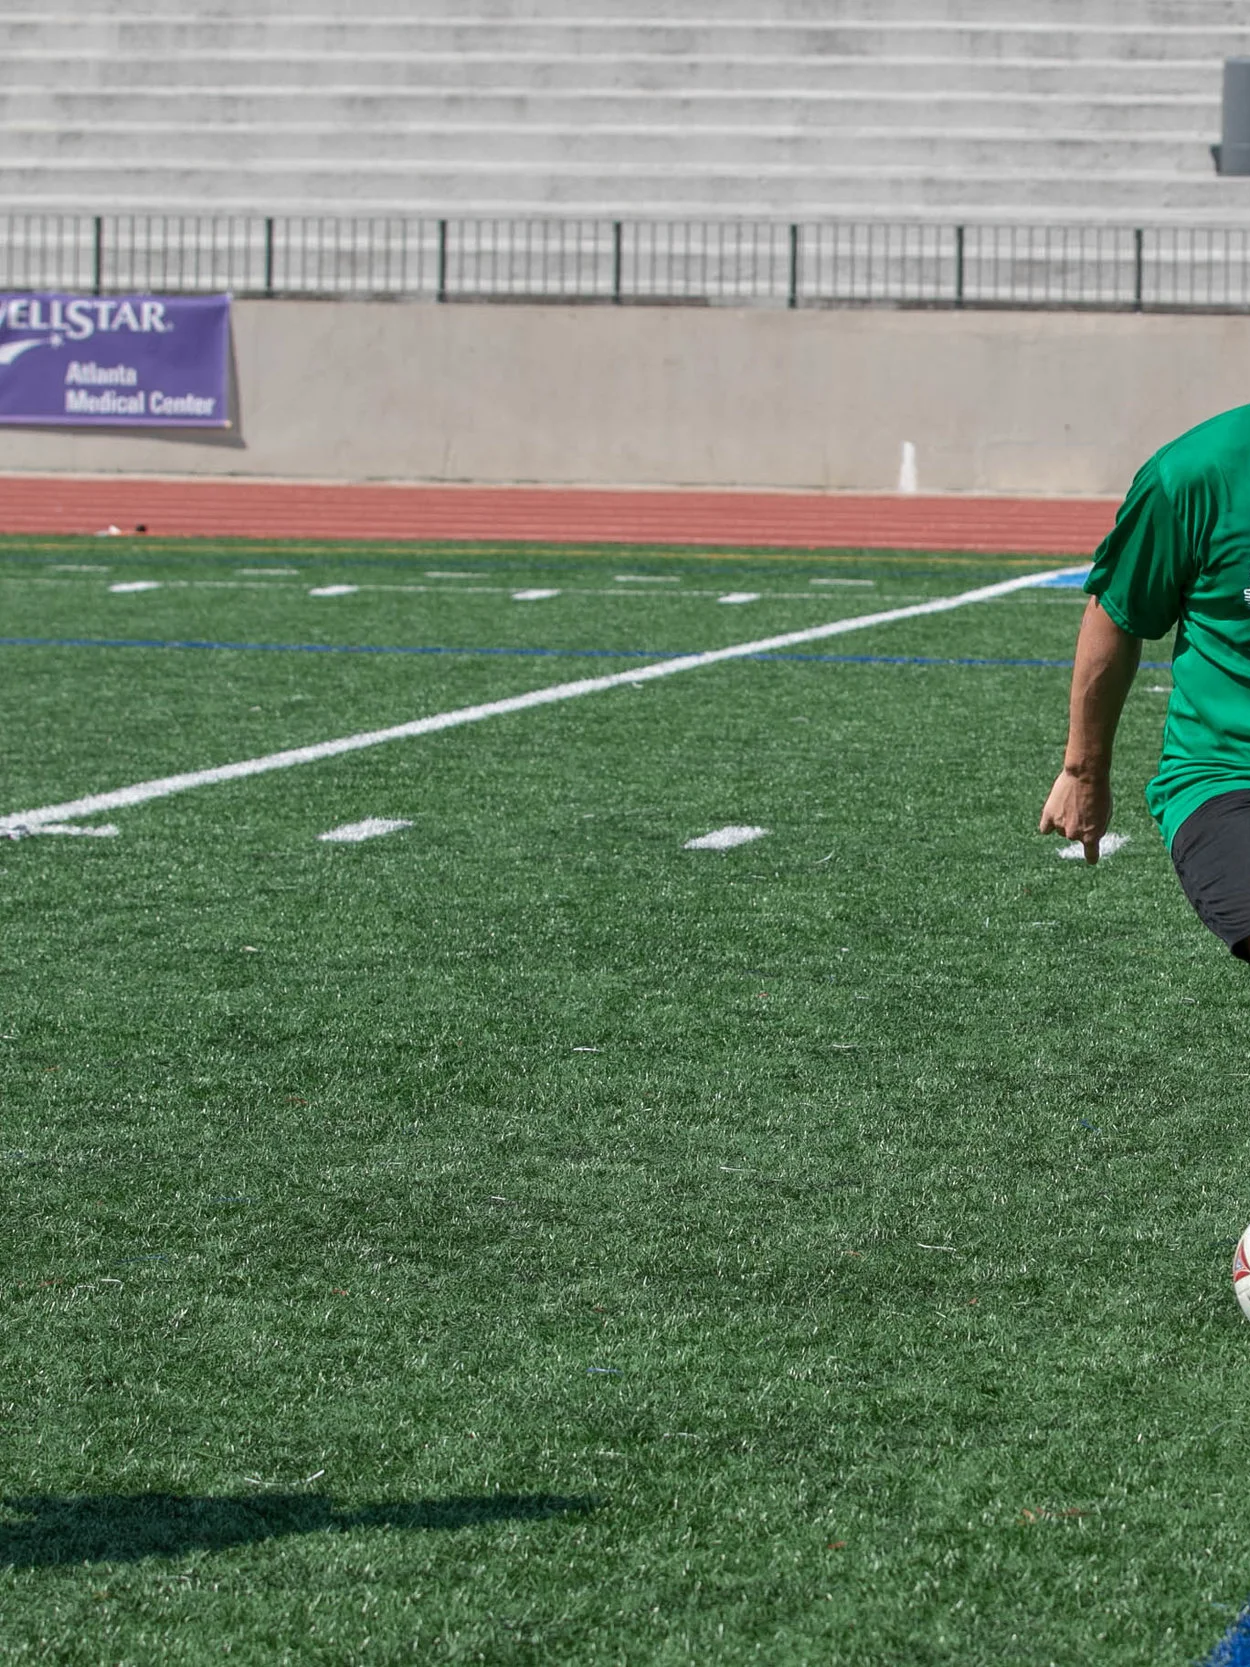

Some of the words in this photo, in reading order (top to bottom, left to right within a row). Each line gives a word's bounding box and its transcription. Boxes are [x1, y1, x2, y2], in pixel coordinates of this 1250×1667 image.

[64, 361, 137, 386] Atlanta
[65, 389, 145, 414] Medical
[149, 391, 215, 416] Center
